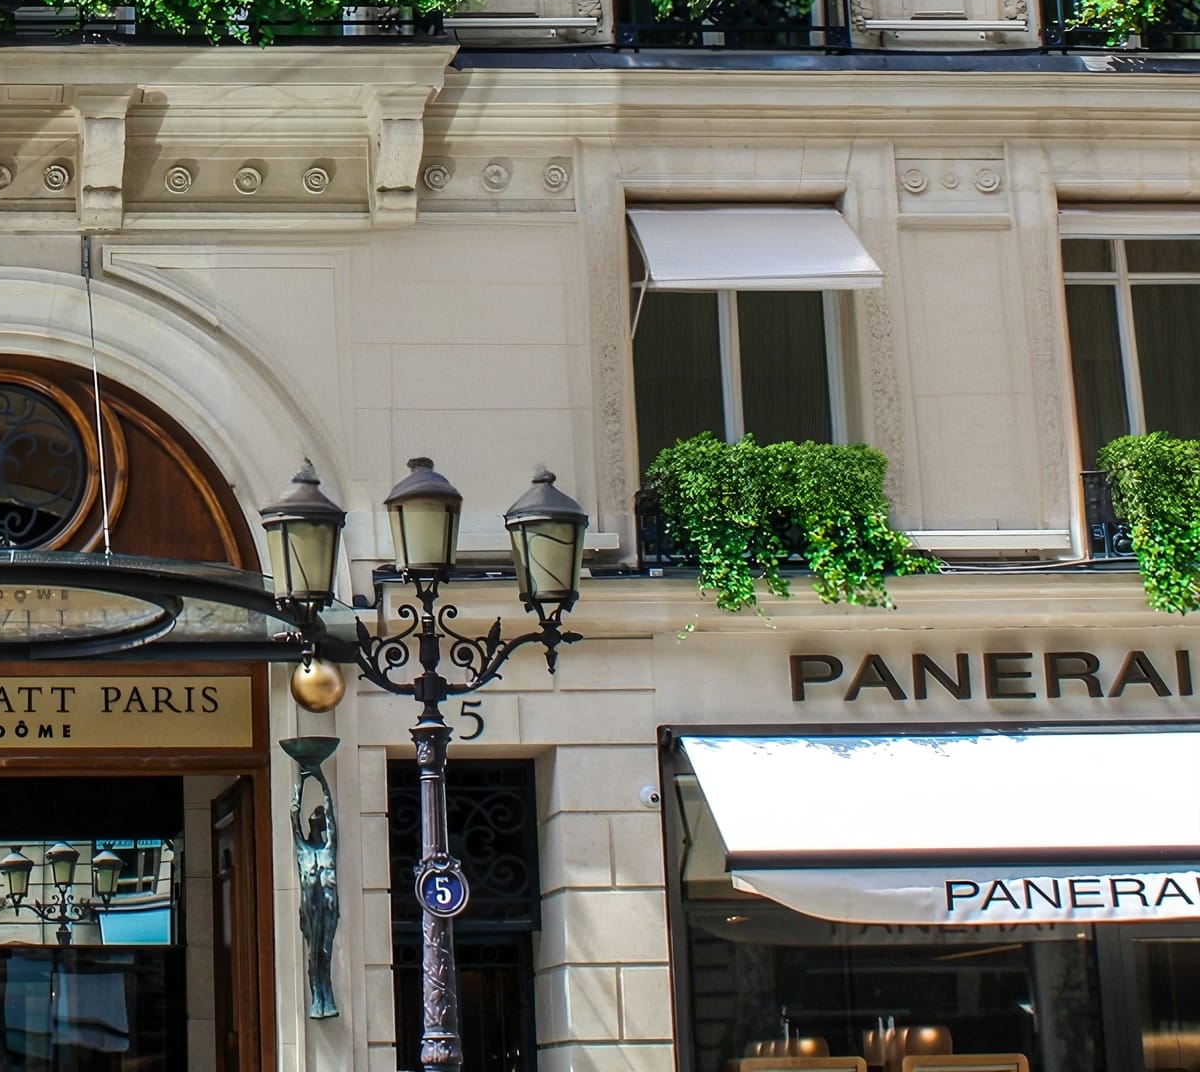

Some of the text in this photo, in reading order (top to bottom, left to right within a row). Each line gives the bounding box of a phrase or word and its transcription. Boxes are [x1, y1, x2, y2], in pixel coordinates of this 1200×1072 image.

[788, 649, 1194, 703] PANERAI
[100, 686, 220, 714] PARIS
[459, 700, 485, 741] 5
[434, 876, 451, 904] 5
